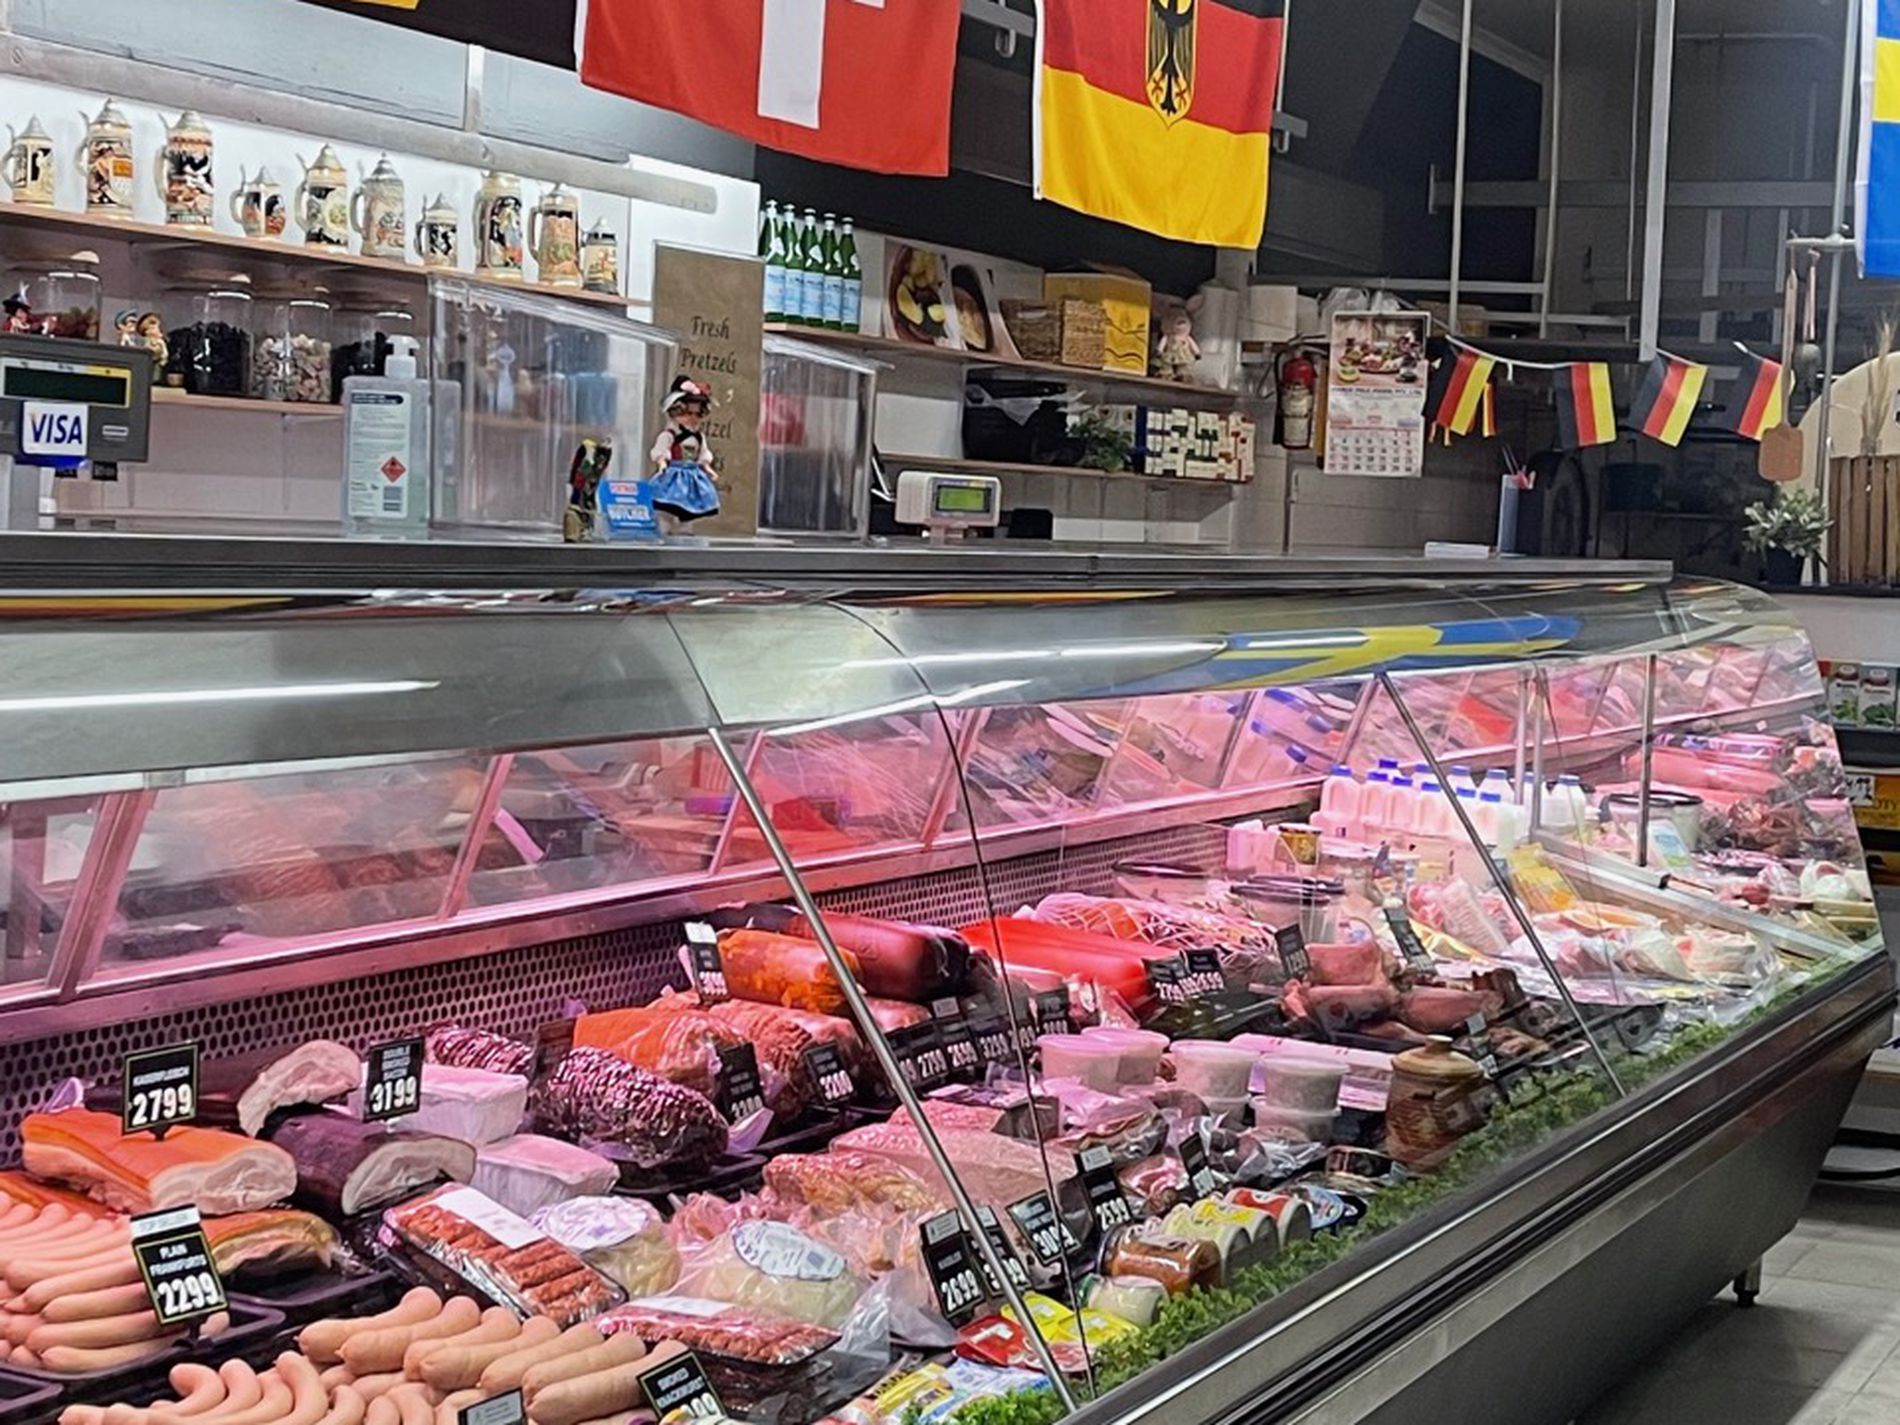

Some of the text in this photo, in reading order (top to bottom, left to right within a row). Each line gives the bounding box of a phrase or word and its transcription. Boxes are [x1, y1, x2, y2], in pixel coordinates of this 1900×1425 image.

[691, 315, 730, 340] Fresh
[680, 347, 737, 375] Pretzels
[30, 413, 83, 444] VISA
[131, 1083, 193, 1127] 2799
[370, 1075, 417, 1113] 3199
[1096, 1197, 1131, 1231] 2599
[157, 1271, 219, 1317] 2299
[940, 1269, 980, 1311] 2699
